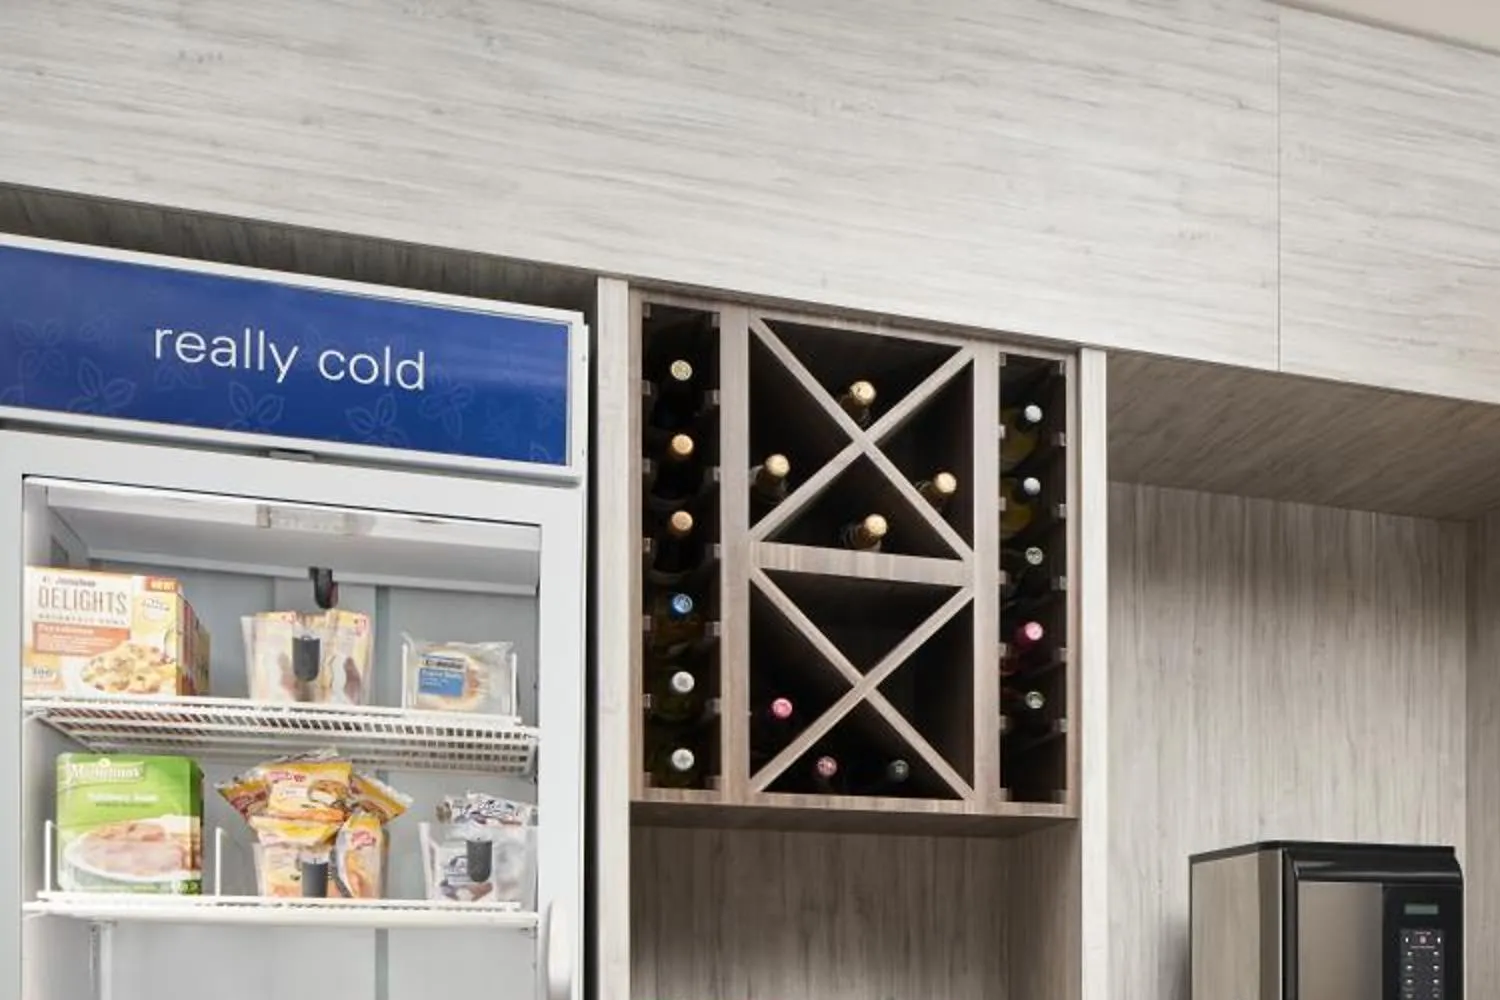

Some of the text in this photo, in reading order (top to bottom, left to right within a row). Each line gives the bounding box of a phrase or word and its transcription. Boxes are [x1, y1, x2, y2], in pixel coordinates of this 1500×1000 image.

[155, 328, 424, 390] really cold
[38, 586, 127, 615] DELIGHTS
